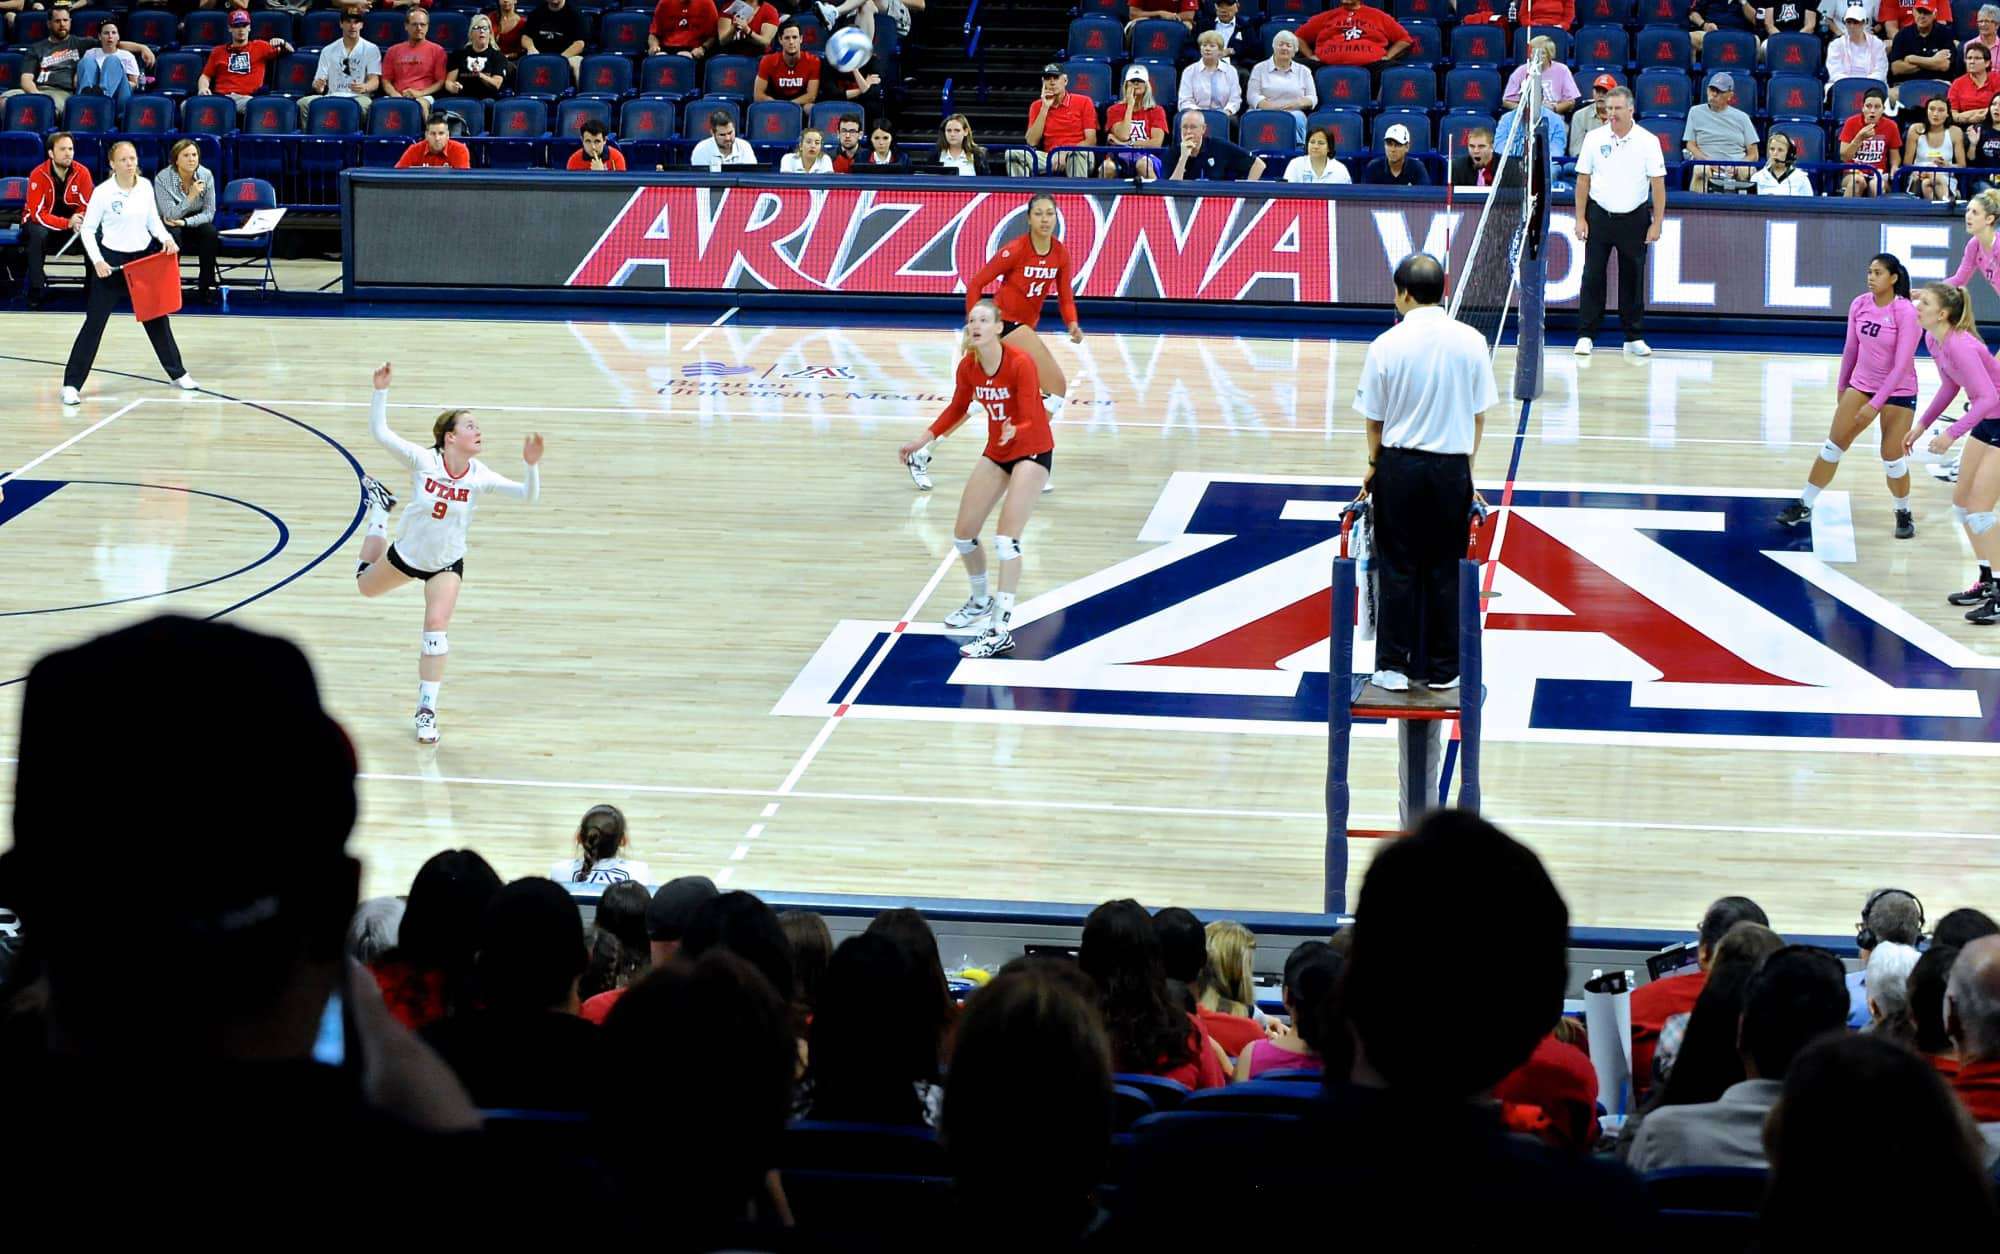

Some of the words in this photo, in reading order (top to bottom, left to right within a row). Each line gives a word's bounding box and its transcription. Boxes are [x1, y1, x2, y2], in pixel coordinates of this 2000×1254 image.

[779, 77, 803, 87] UTAH
[564, 186, 1339, 302] ARIZONA
[1023, 266, 1058, 279] UTAH
[1026, 281, 1045, 298] 14
[1860, 320, 1882, 338] 20
[666, 379, 793, 390] Banner
[656, 387, 838, 400] University
[848, 391, 947, 401] Medic
[975, 386, 1011, 401] UTAH
[986, 403, 1007, 421] 17
[424, 477, 470, 503] UTAH
[431, 501, 448, 520] 9
